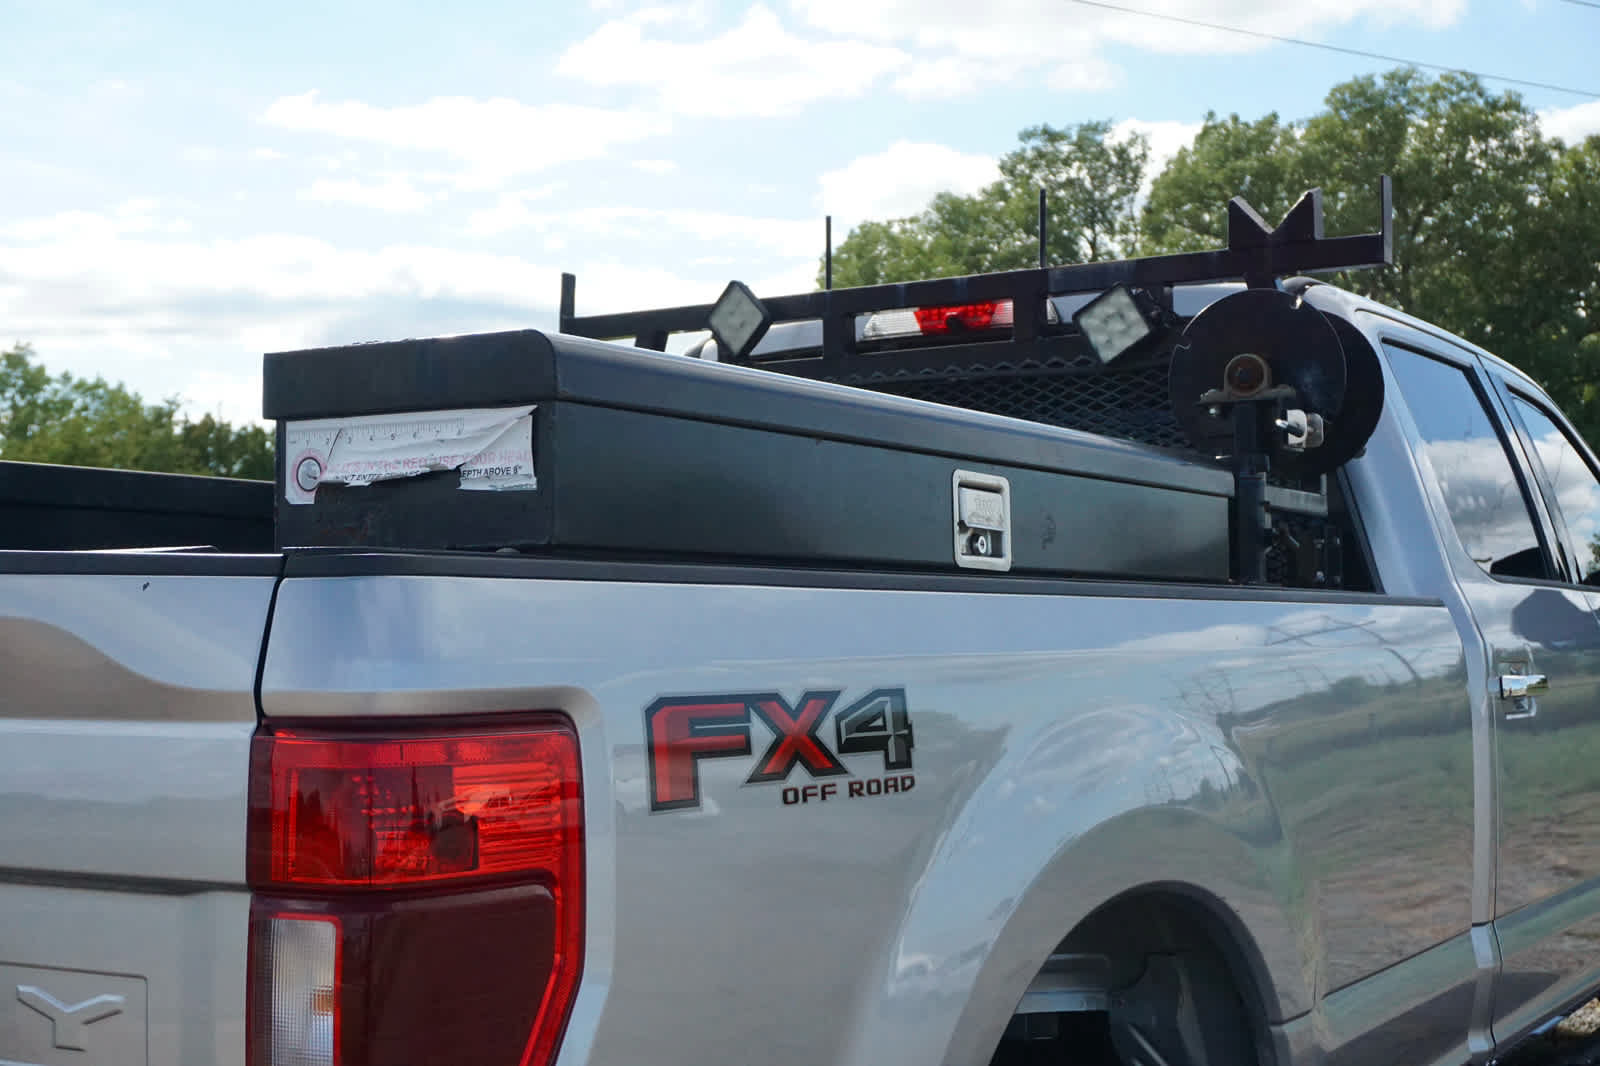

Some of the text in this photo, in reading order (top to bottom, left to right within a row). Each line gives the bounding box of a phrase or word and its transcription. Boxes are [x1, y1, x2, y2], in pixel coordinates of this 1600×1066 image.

[484, 466, 511, 477] ABOVE
[643, 687, 915, 813] FX4
[781, 775, 916, 806] OFF ROAD
